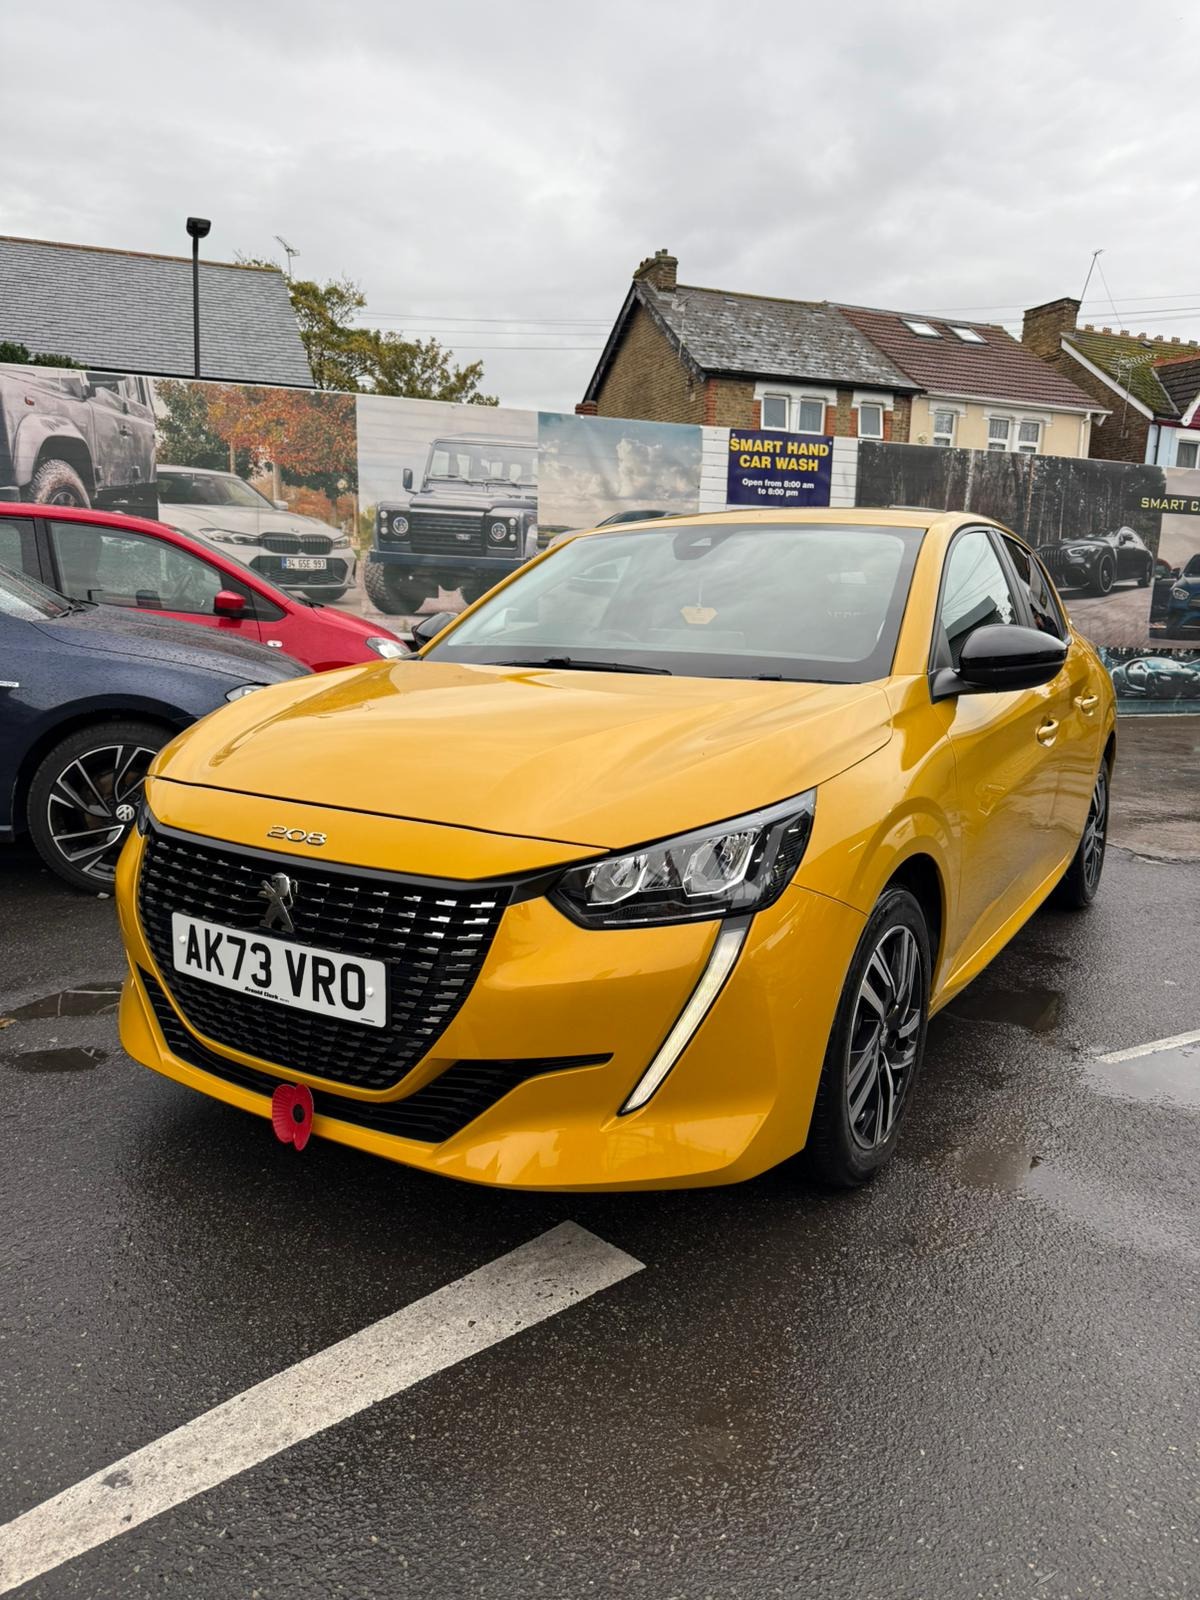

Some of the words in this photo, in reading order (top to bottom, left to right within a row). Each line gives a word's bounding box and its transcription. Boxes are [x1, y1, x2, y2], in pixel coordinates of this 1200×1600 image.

[730, 438, 783, 453] SMART
[787, 441, 829, 456] HAND
[739, 455, 771, 468] CAR
[776, 457, 818, 471] WASH
[742, 478, 762, 487] Open
[764, 479, 782, 487] from
[1140, 497, 1187, 510] SMART
[1190, 500, 1200, 512] C
[267, 825, 327, 846] 208
[186, 924, 272, 989] AK73
[284, 949, 366, 1011] VRO
